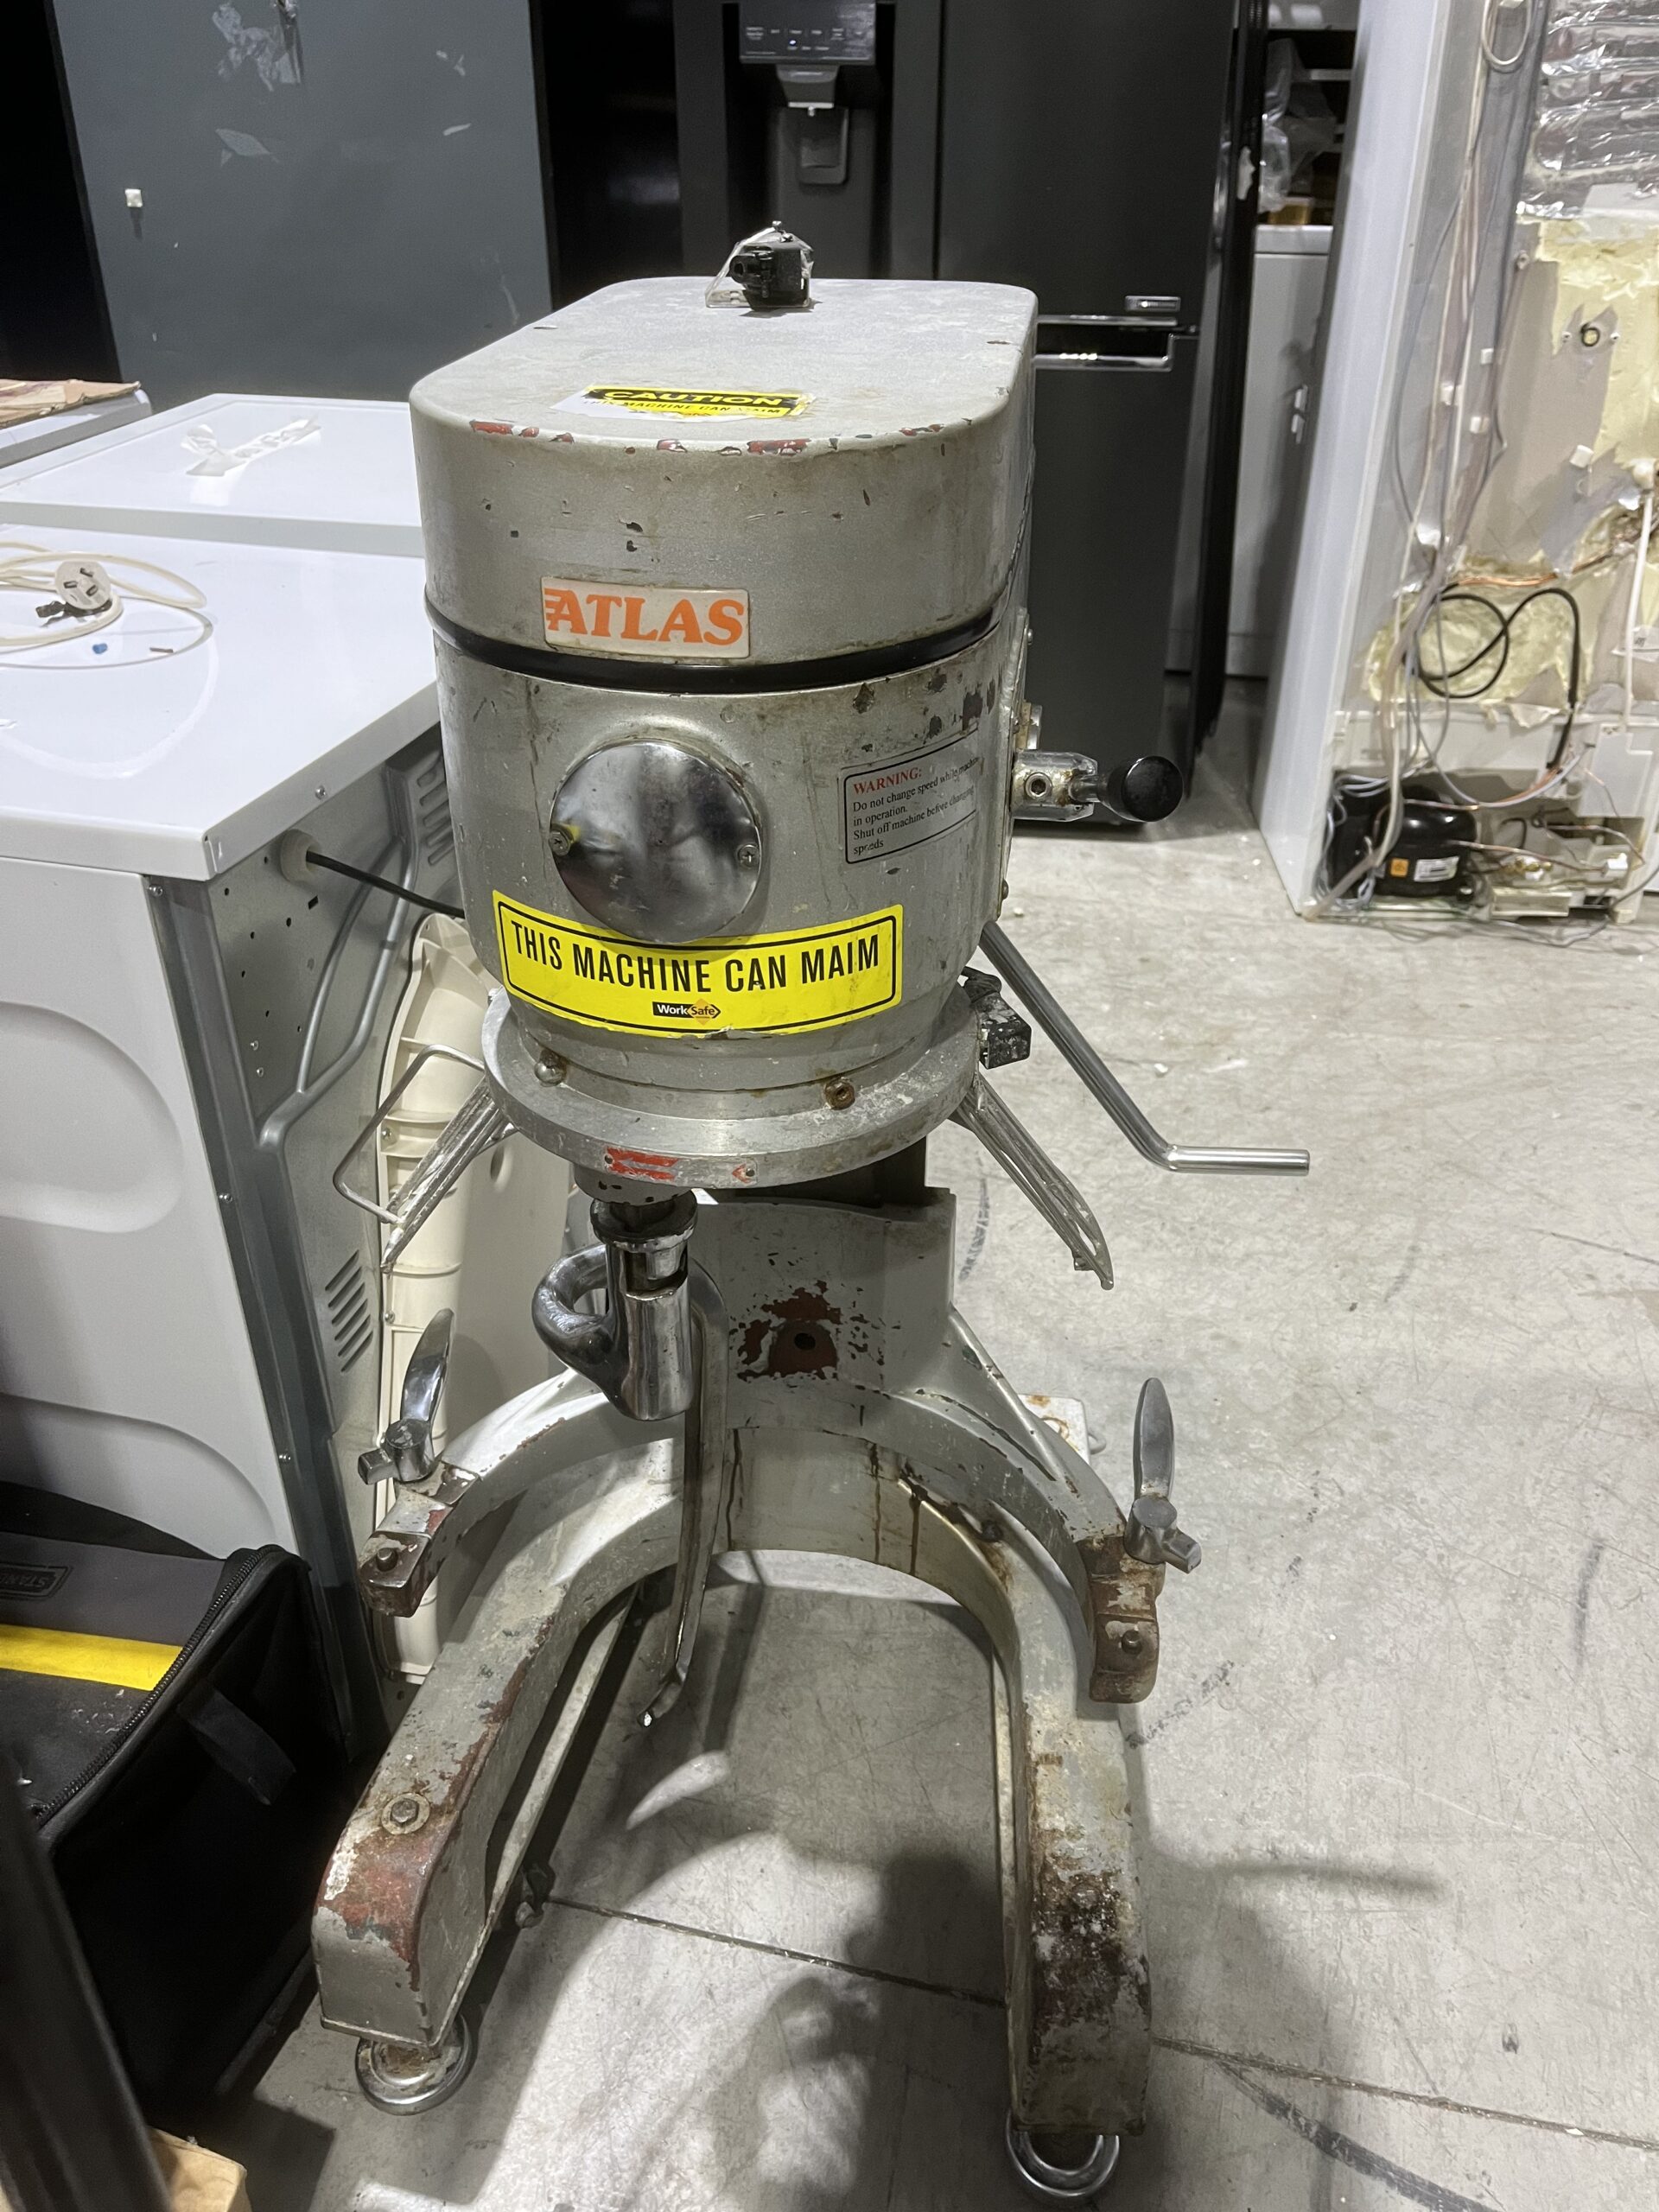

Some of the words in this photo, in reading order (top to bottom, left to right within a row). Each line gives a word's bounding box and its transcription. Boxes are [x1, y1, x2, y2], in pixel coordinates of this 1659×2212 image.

[604, 391, 783, 406] CAUTION
[543, 588, 745, 645] ATLAS
[853, 767, 922, 794] WARNING:
[853, 801, 868, 812] Do
[870, 797, 884, 808] not
[887, 788, 916, 803] change
[918, 777, 938, 794] speed
[853, 828, 874, 840] Shut
[877, 821, 892, 834] off
[892, 812, 925, 830] machine
[926, 801, 948, 817] before
[854, 817, 862, 826] in
[865, 805, 908, 824] operation.
[511, 920, 563, 969] THIS
[573, 944, 711, 993] MACHINE
[725, 955, 787, 993] CAN
[801, 933, 880, 983] MAIM
[657, 1004, 715, 1015] WorkSafe
